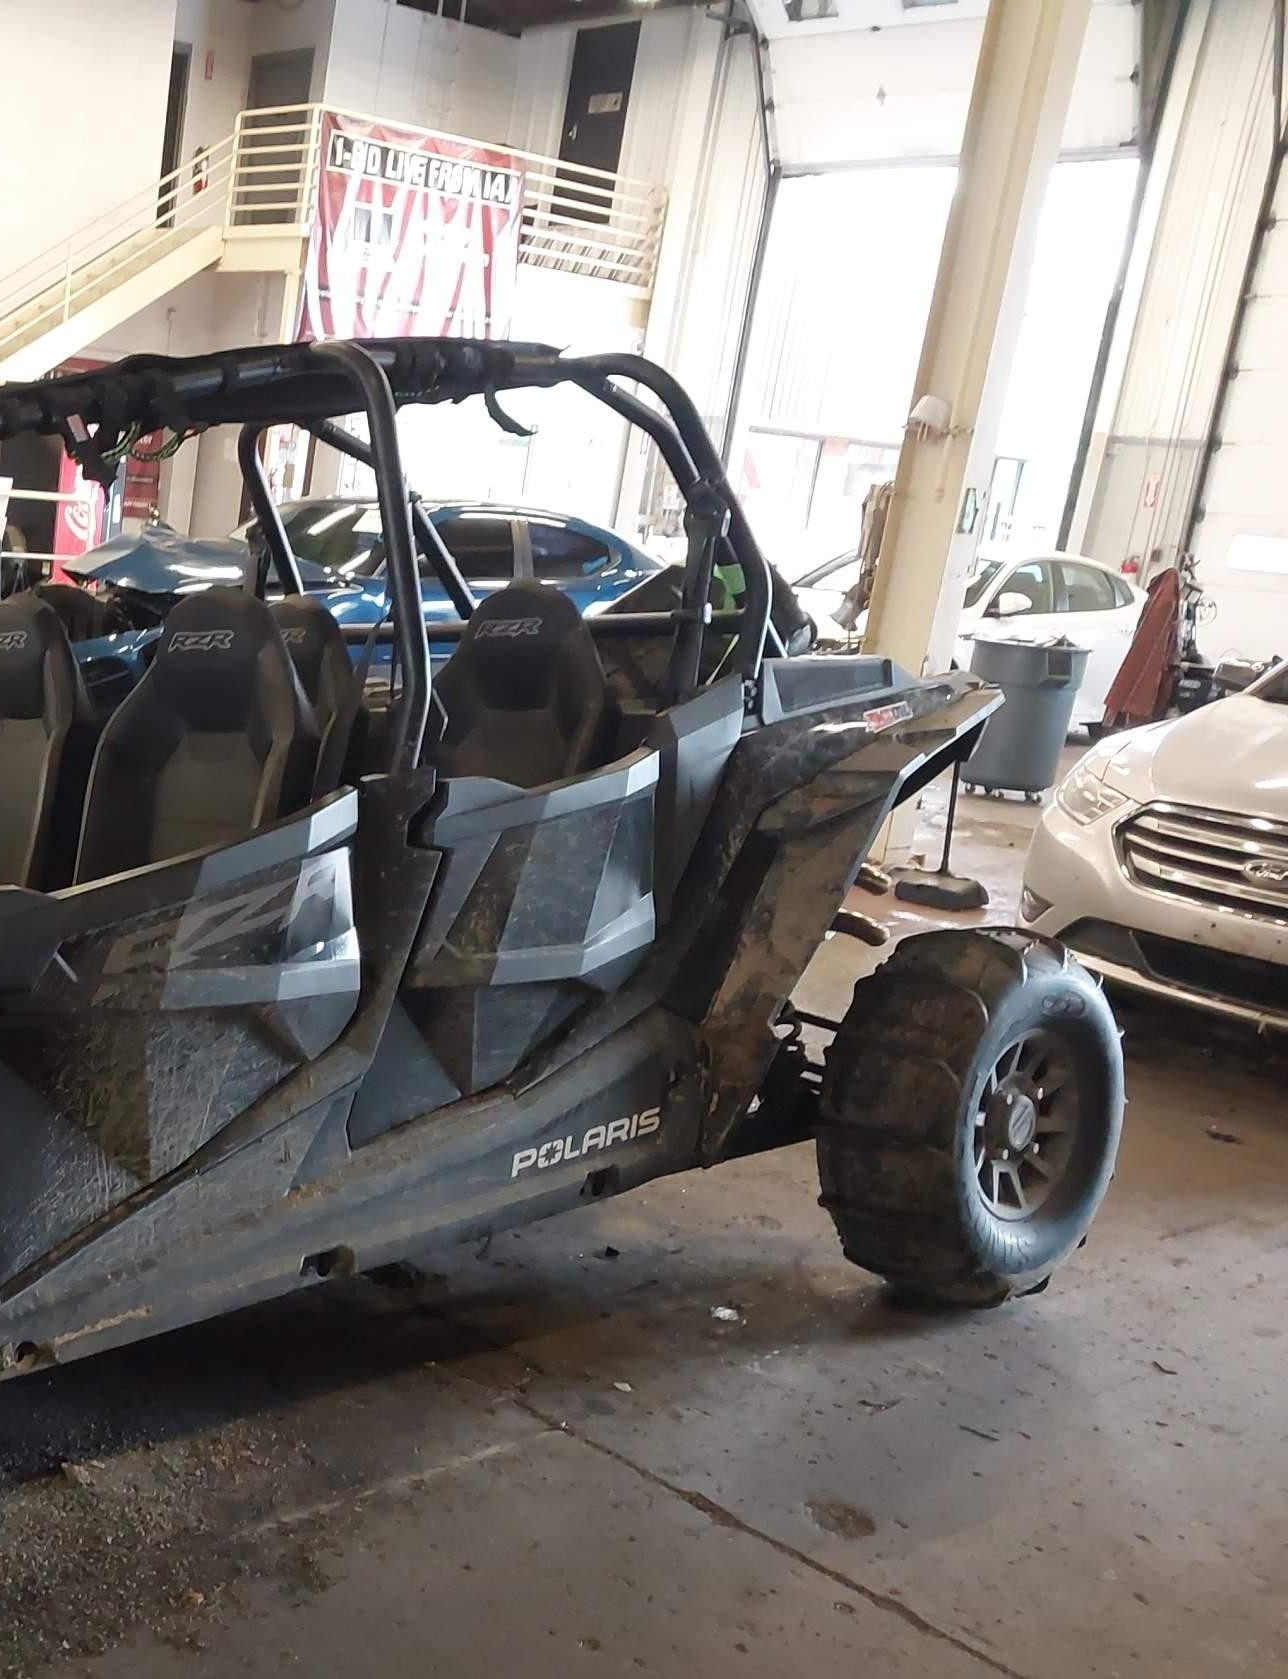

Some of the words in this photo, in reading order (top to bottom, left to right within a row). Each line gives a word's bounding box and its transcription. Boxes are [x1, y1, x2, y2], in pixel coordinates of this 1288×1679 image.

[427, 159, 482, 198] FROM
[168, 629, 234, 653] RZR
[474, 617, 543, 640] RZR
[511, 1106, 661, 1178] POLARIS
